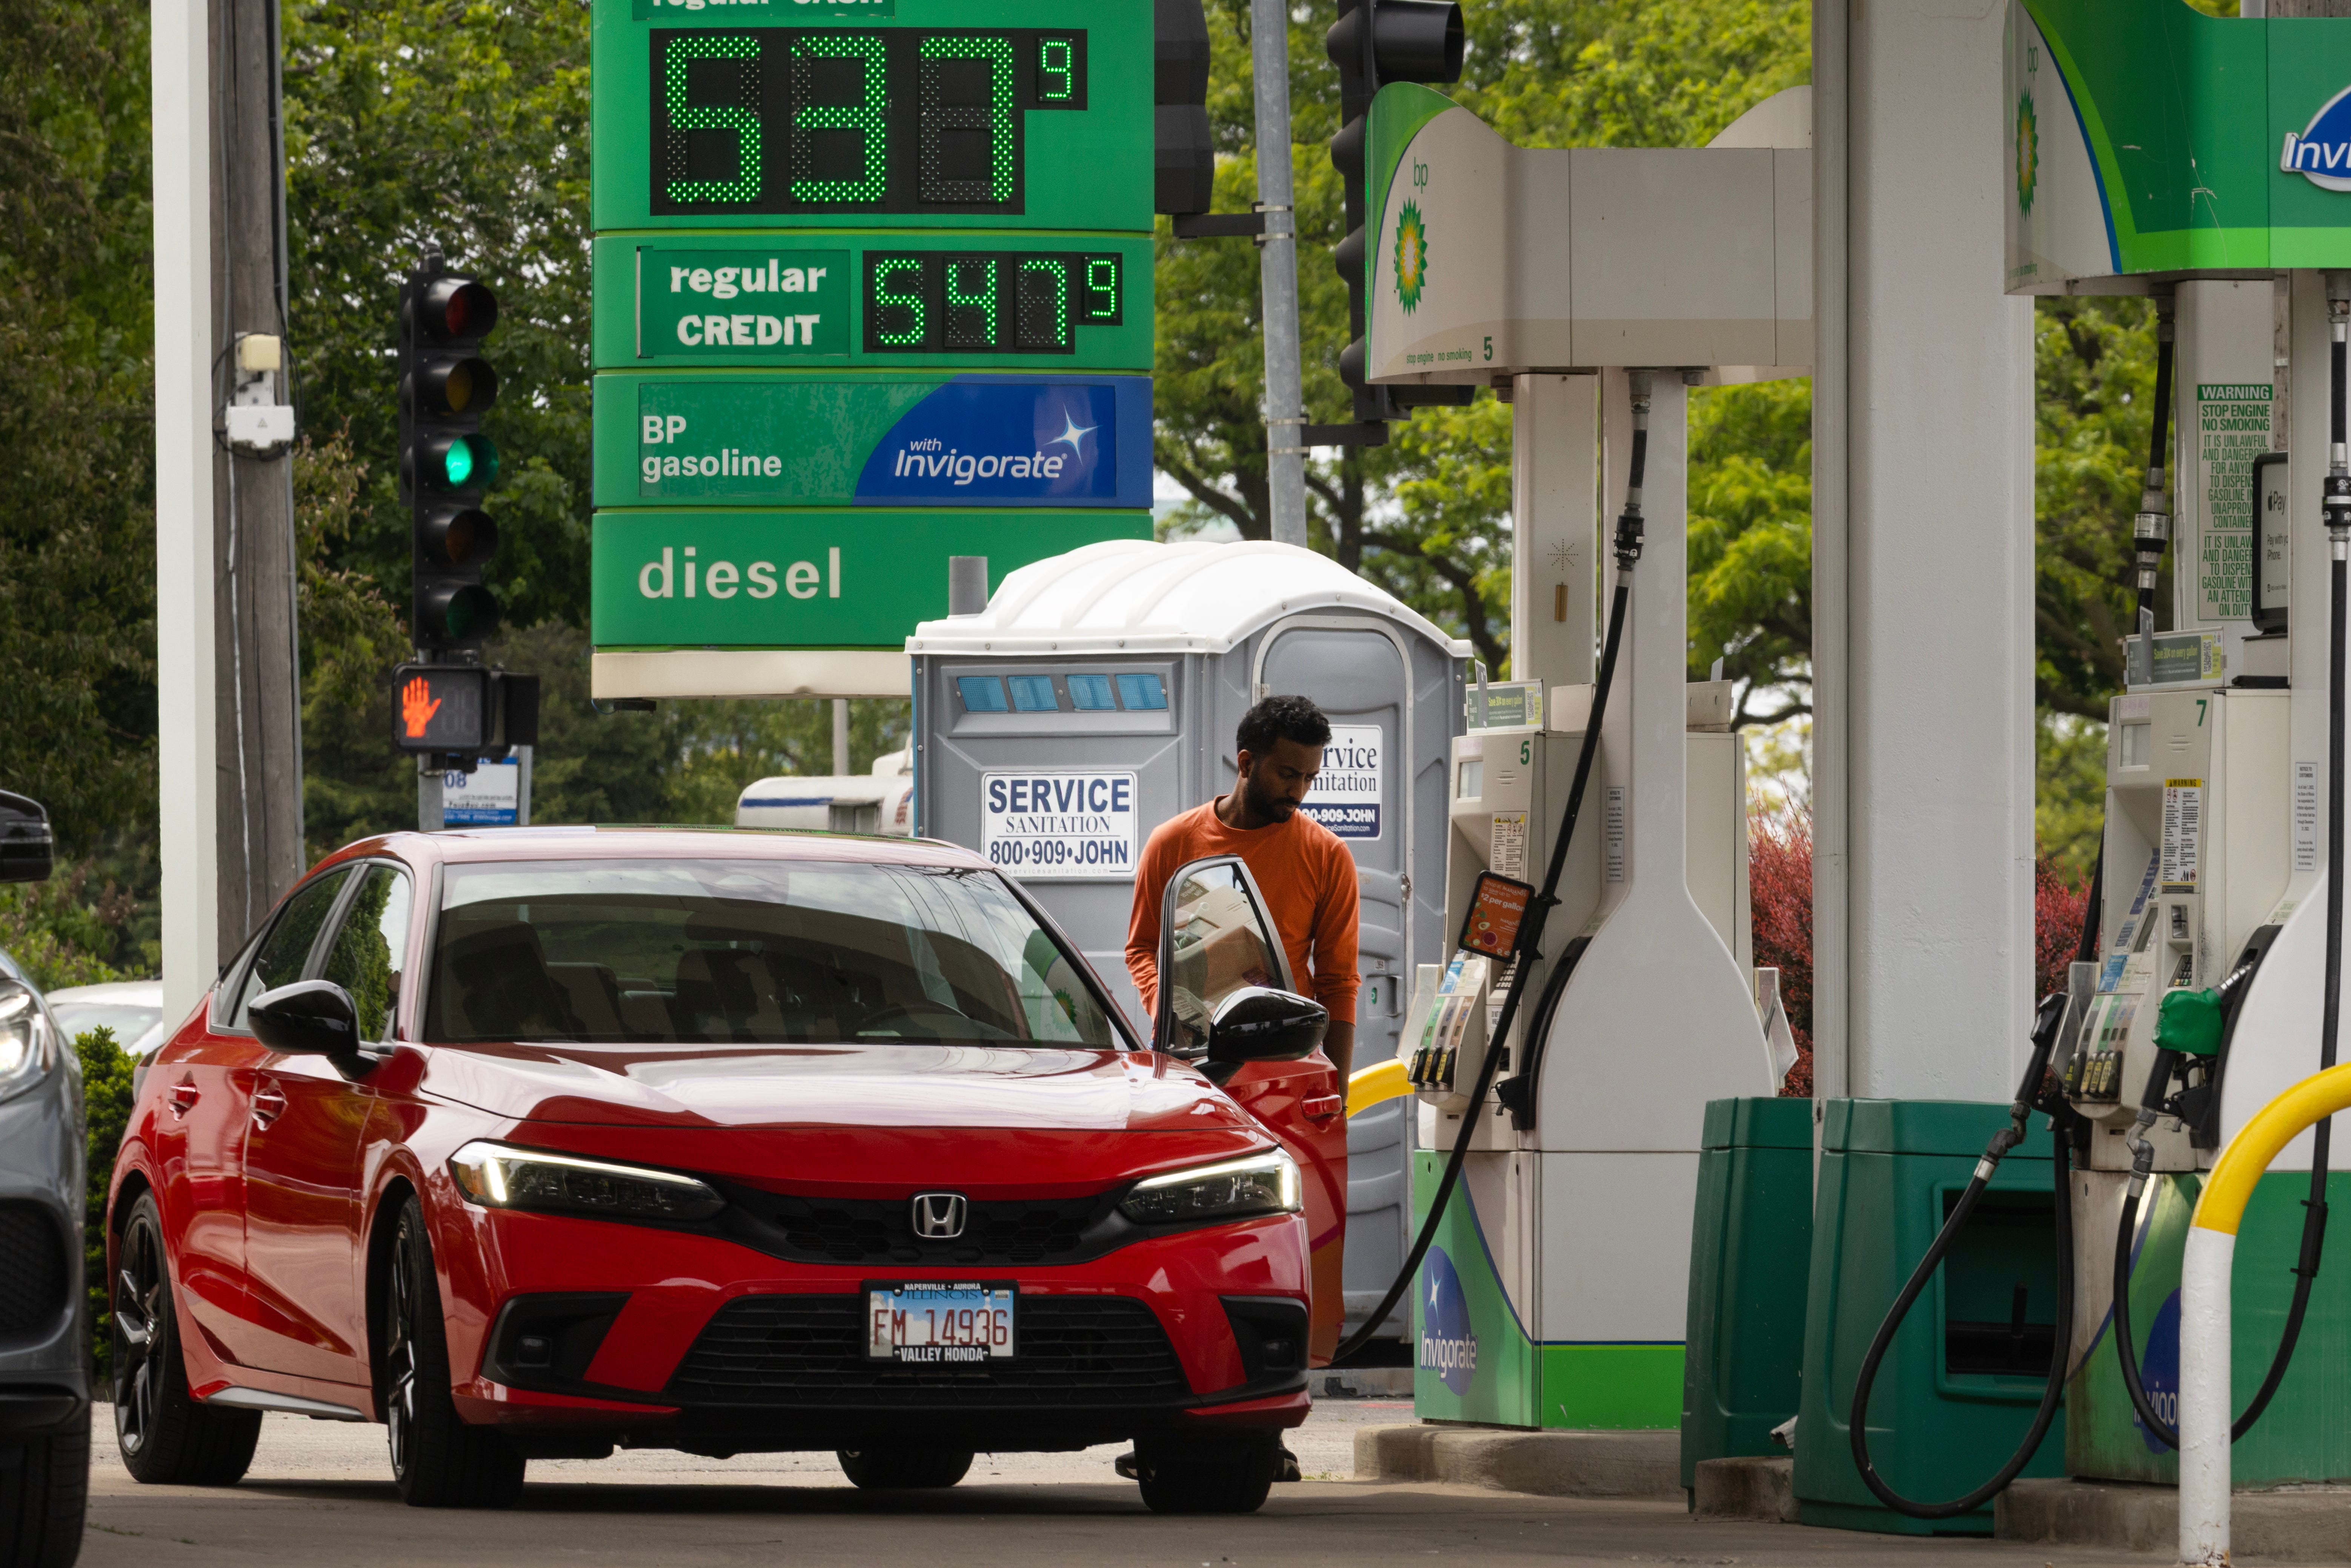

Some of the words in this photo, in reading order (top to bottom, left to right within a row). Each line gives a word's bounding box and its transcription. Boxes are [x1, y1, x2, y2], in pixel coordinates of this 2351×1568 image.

[2028, 39, 2038, 81] bp
[666, 37, 1013, 202] 537
[1413, 157, 1428, 194] bp
[670, 258, 826, 299] regular
[876, 260, 1066, 345] 547
[678, 314, 821, 346] CREDIT
[1407, 353, 1416, 366] stop
[1417, 350, 1434, 365] engine
[1438, 352, 1445, 361] no
[1446, 347, 1472, 362] smoking
[1483, 336, 1493, 361] 5
[2202, 386, 2269, 399] WARNING
[2202, 404, 2229, 417] STOP
[2231, 404, 2270, 417] ENGINE
[642, 416, 687, 444] BP
[2202, 418, 2217, 431] NO
[2220, 418, 2270, 431] SMOKING
[910, 437, 942, 451] with
[2204, 435, 2211, 447] IT
[2214, 435, 2221, 447] IS
[2224, 435, 2268, 447] UNLAWFUL
[2202, 448, 2219, 461] AND
[642, 449, 782, 483] gasoline
[2211, 461, 2226, 474] FOR
[2210, 475, 2219, 487] TO
[2208, 489, 2245, 501] GASOLINE
[2273, 491, 2286, 515] Pay
[2211, 502, 2252, 514] UNAPPROV
[2205, 535, 2211, 548] IT
[2215, 535, 2222, 548] IS
[2224, 535, 2253, 548] UNLAW
[2203, 549, 2219, 562] AND
[2222, 549, 2253, 562] DANGER
[638, 547, 840, 599] diesel
[2210, 563, 2220, 575] TO
[2223, 563, 2252, 575] DISPEN
[2202, 576, 2236, 589] GASOLINE
[2207, 590, 2218, 603] AN
[2221, 590, 2251, 603] ATTEND
[2219, 603, 2230, 616] ON
[2196, 699, 2207, 726] 7
[1321, 738, 1377, 768] rvice
[1520, 740, 1530, 765] 5
[1313, 772, 1377, 791] nitation
[989, 779, 1130, 813] SERVICE
[1006, 815, 1111, 833] SANITATION
[1481, 893, 1489, 901] $2
[1488, 897, 1502, 905] per
[907, 1290, 978, 1300] ILLINOIS
[874, 1309, 906, 1345] FM
[925, 1309, 1008, 1345] 14936
[901, 1347, 941, 1362] VALLEY
[944, 1347, 984, 1362] HONDA
